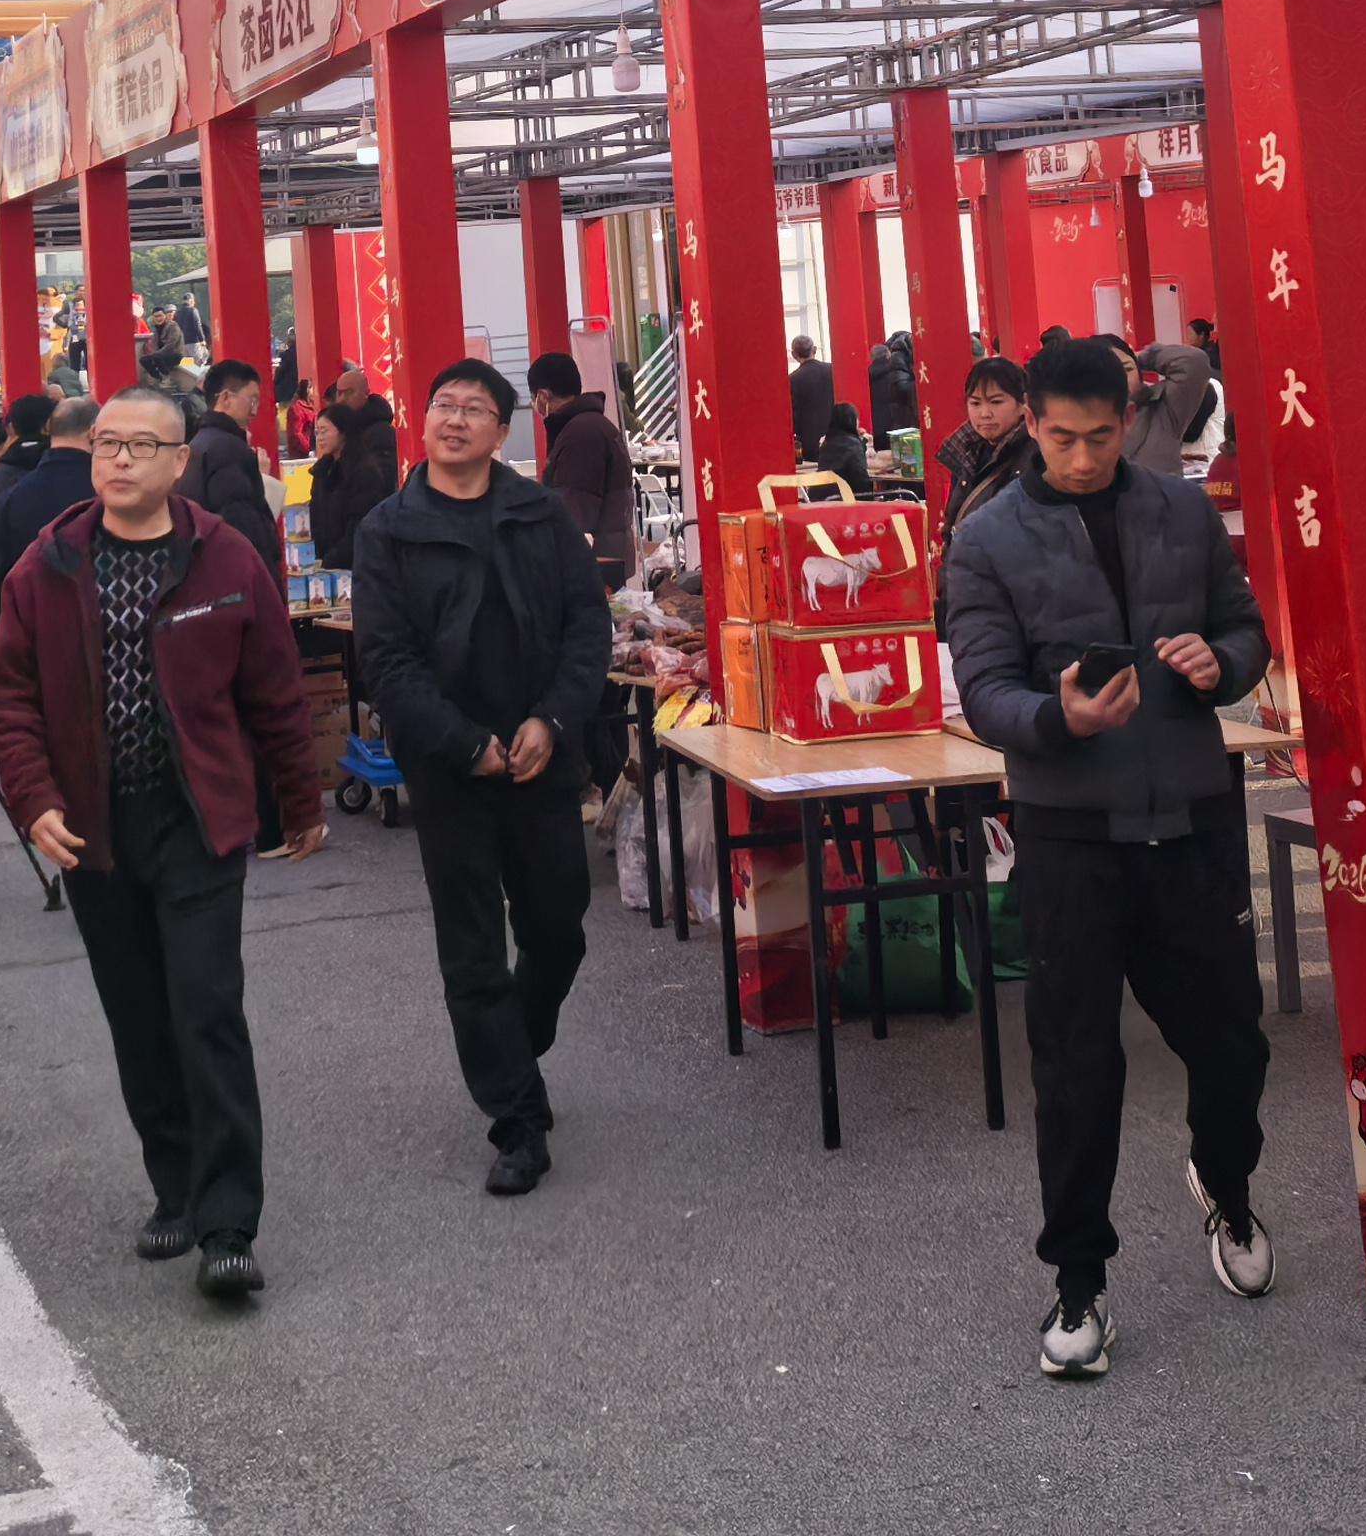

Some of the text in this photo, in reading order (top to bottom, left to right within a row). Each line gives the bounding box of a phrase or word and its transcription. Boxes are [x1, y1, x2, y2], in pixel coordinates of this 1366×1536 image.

[681, 220, 715, 503] 马年大吉
[911, 272, 933, 431] 马年大吉
[1255, 131, 1321, 548] 马年大吉
